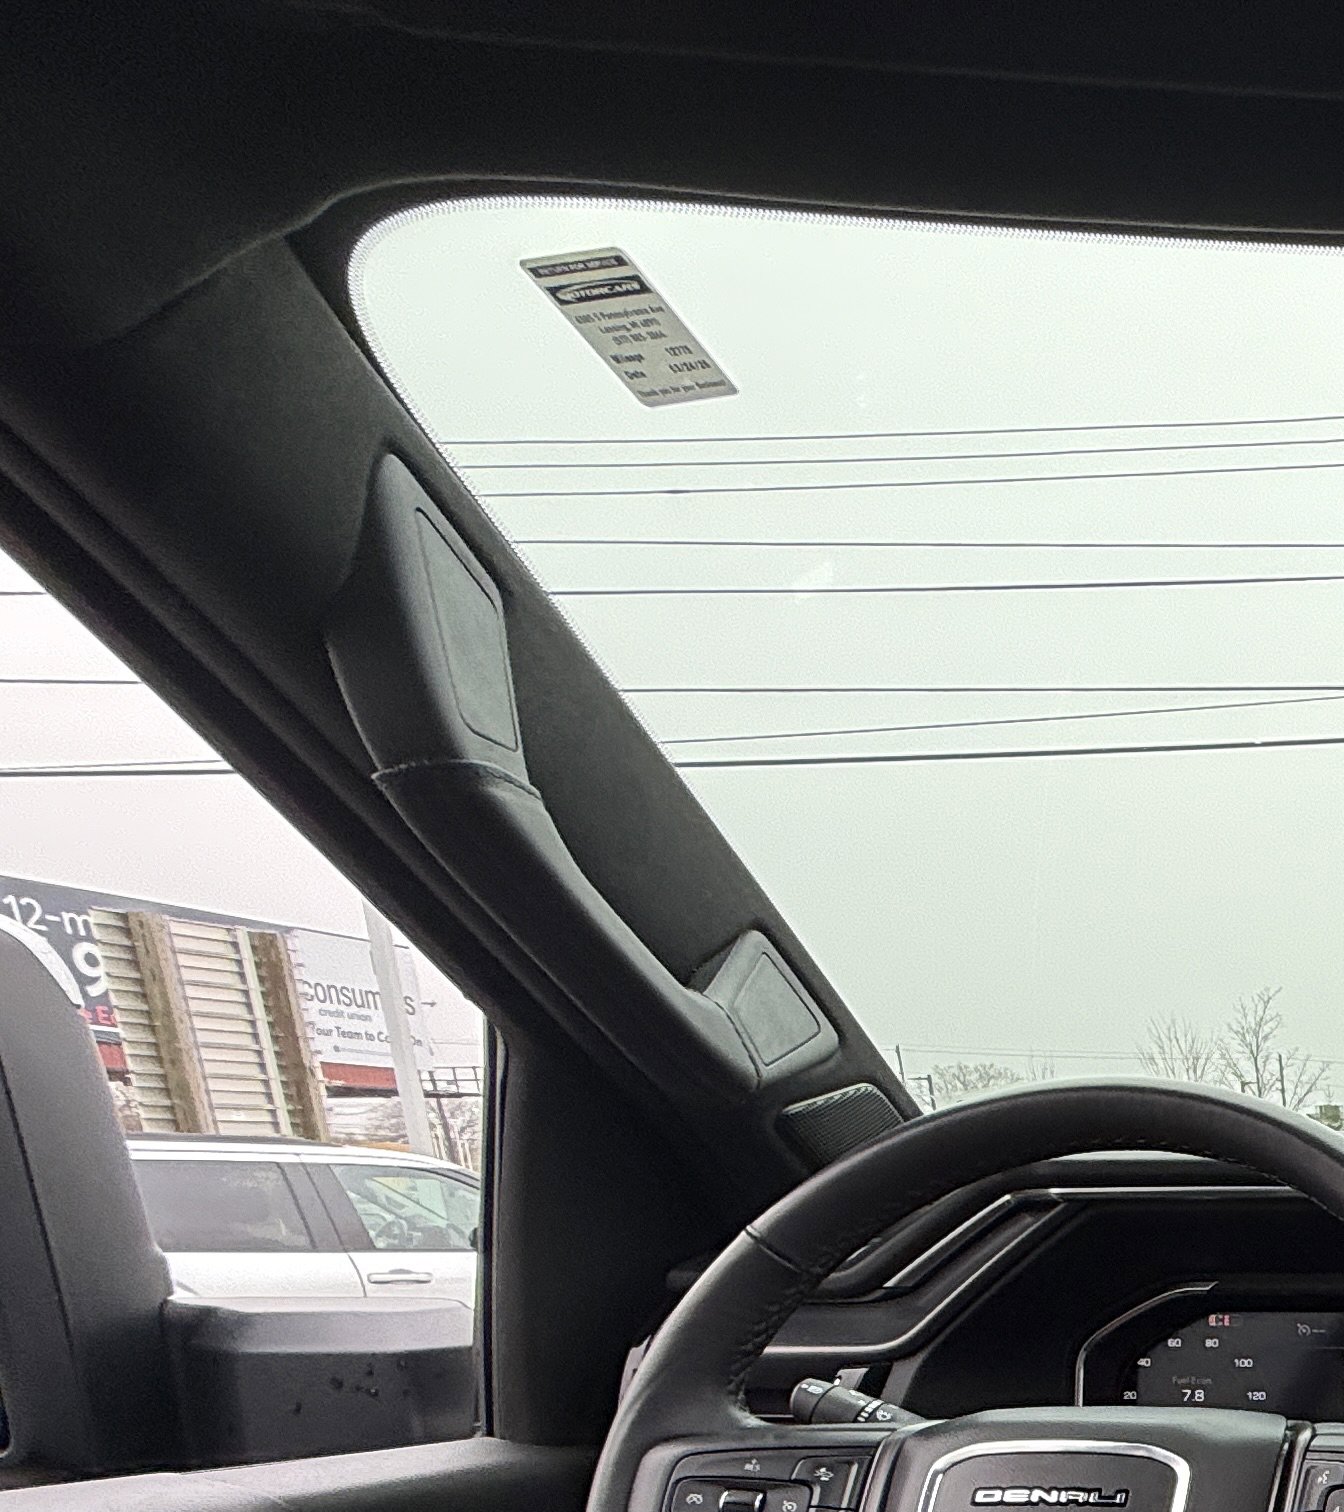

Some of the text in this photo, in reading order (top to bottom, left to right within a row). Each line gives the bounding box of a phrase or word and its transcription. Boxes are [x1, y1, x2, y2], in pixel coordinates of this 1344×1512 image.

[610, 353, 645, 364] Mileage
[624, 370, 647, 380] Date
[301, 980, 416, 1016] consums
[319, 1008, 345, 1019] credit
[335, 1026, 363, 1041] Team
[365, 1031, 376, 1042] to
[1168, 1338, 1182, 1348] 60
[1205, 1338, 1219, 1348] 80
[1137, 1358, 1151, 1367] 40
[1234, 1358, 1253, 1368] 100
[1123, 1391, 1138, 1400] 20
[1182, 1389, 1205, 1402] 7.8
[1246, 1391, 1267, 1401] 120
[975, 1488, 1127, 1504] DENALI
